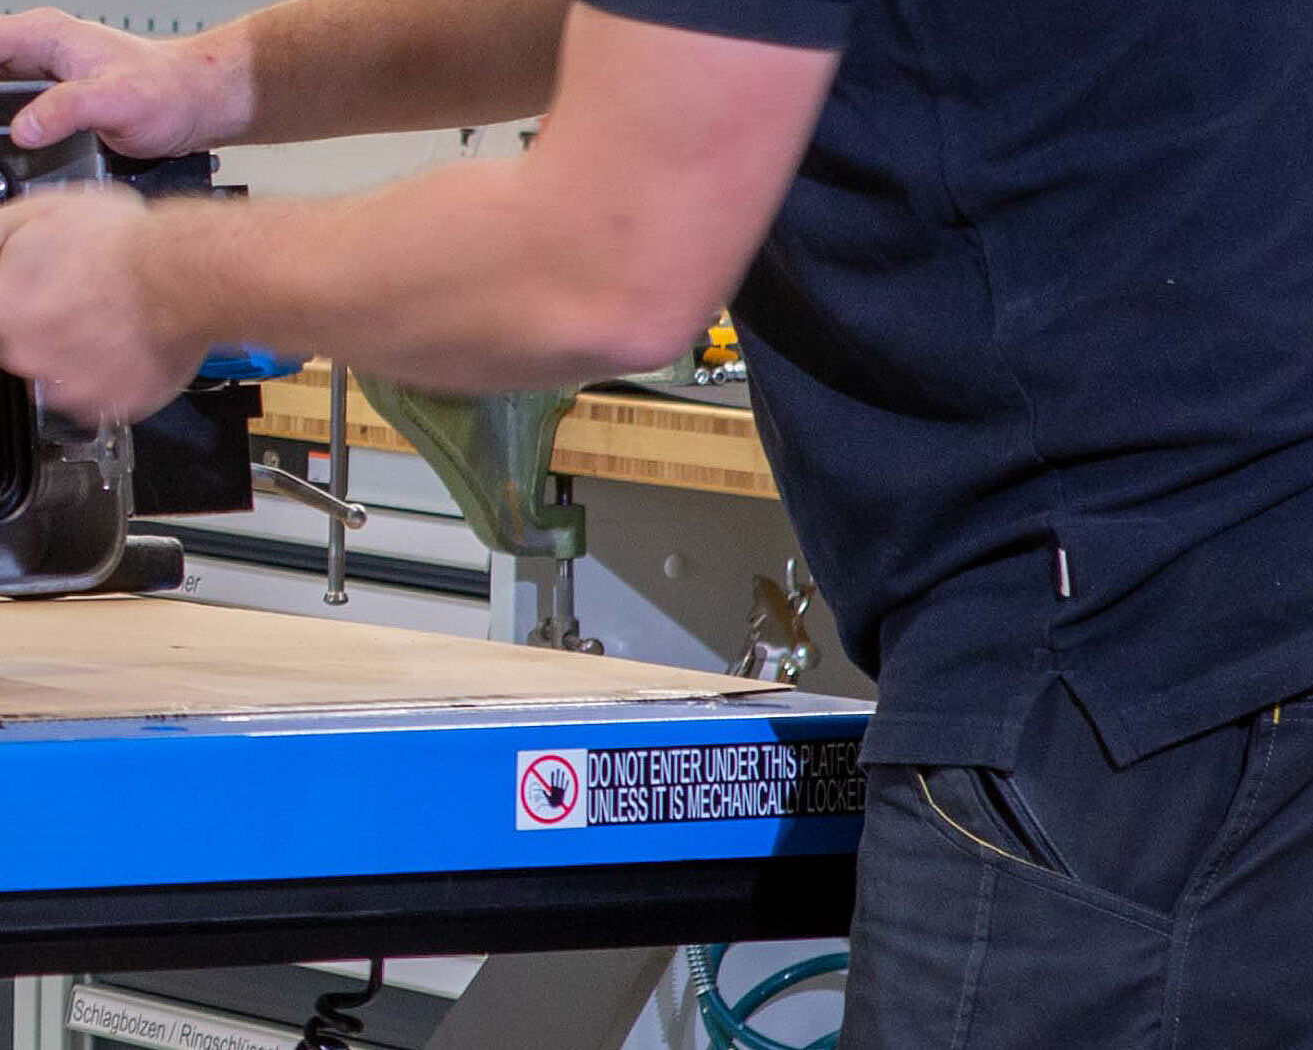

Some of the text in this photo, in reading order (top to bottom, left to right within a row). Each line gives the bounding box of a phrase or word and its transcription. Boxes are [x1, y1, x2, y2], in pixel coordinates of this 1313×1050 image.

[588, 753, 611, 787] DO
[615, 752, 647, 786] NOT
[650, 749, 702, 785] ENTER
[705, 747, 758, 783] UNDER
[761, 745, 796, 780] THIS
[588, 786, 648, 824] UNLESS
[652, 786, 666, 821] IT
[669, 785, 684, 820] IS
[687, 780, 803, 818] MECHANICALLY
[73, 997, 166, 1040] Schlagbolzen
